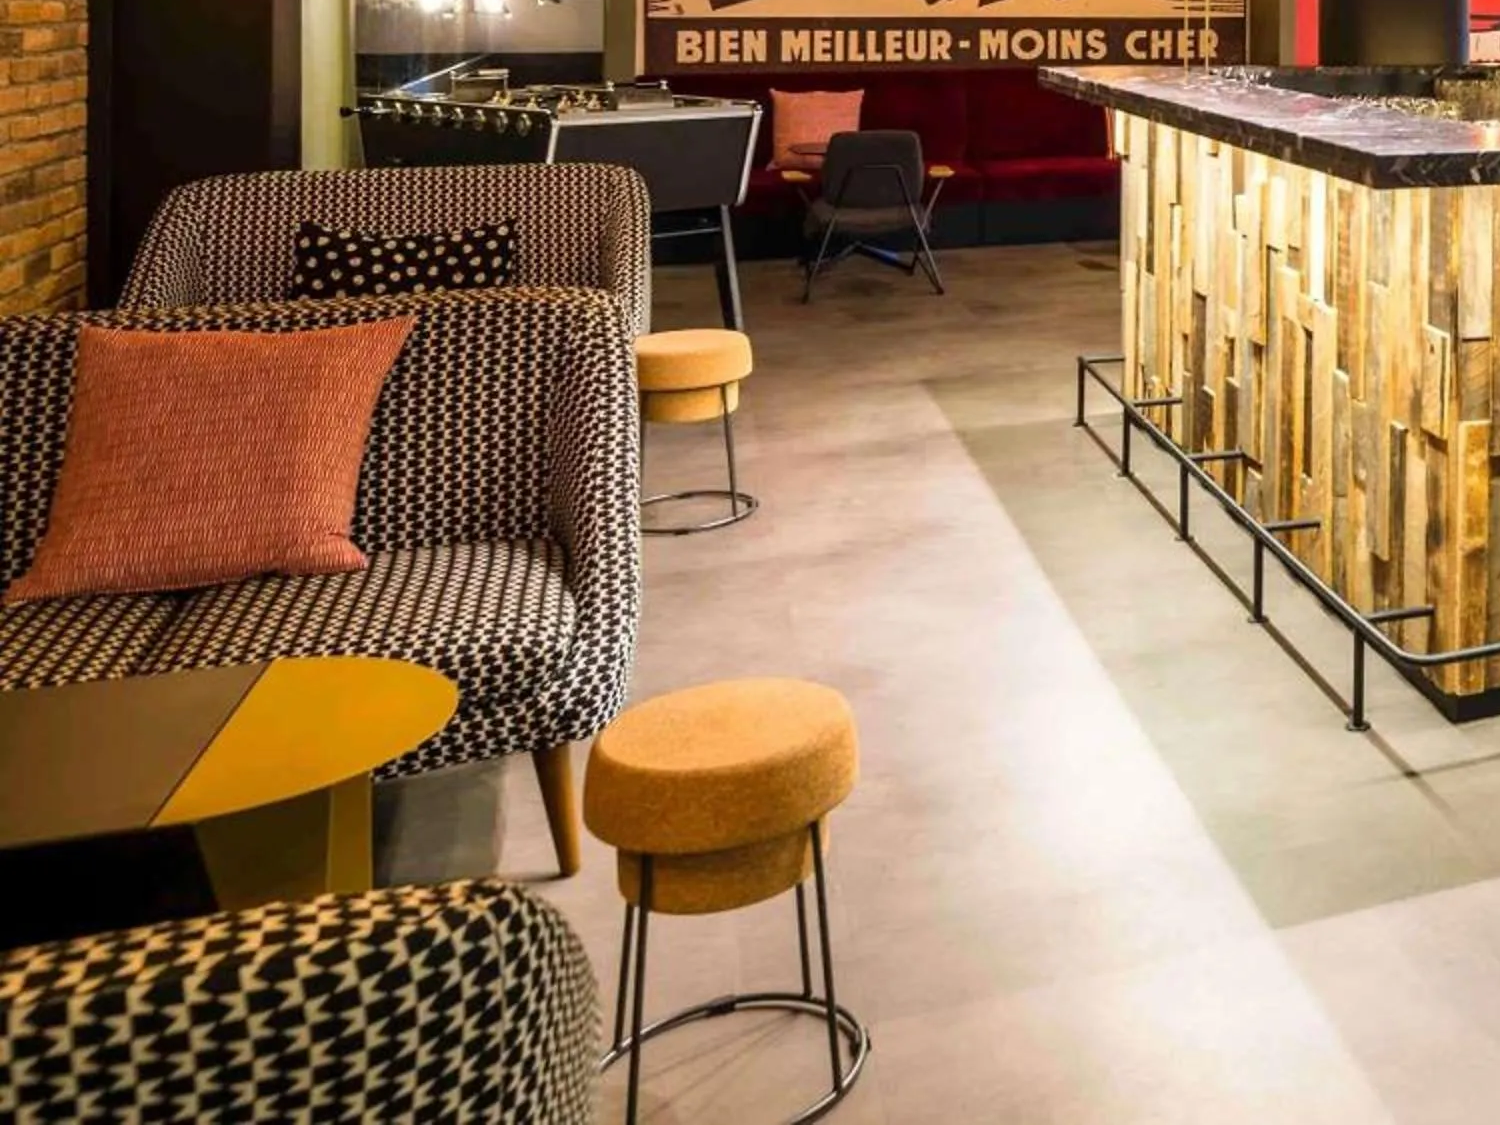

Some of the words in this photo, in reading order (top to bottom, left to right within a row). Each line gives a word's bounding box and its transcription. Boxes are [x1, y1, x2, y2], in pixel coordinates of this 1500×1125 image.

[676, 29, 768, 64] BIEN
[979, 28, 1108, 61] MOINS
[1125, 29, 1219, 60] CHER
